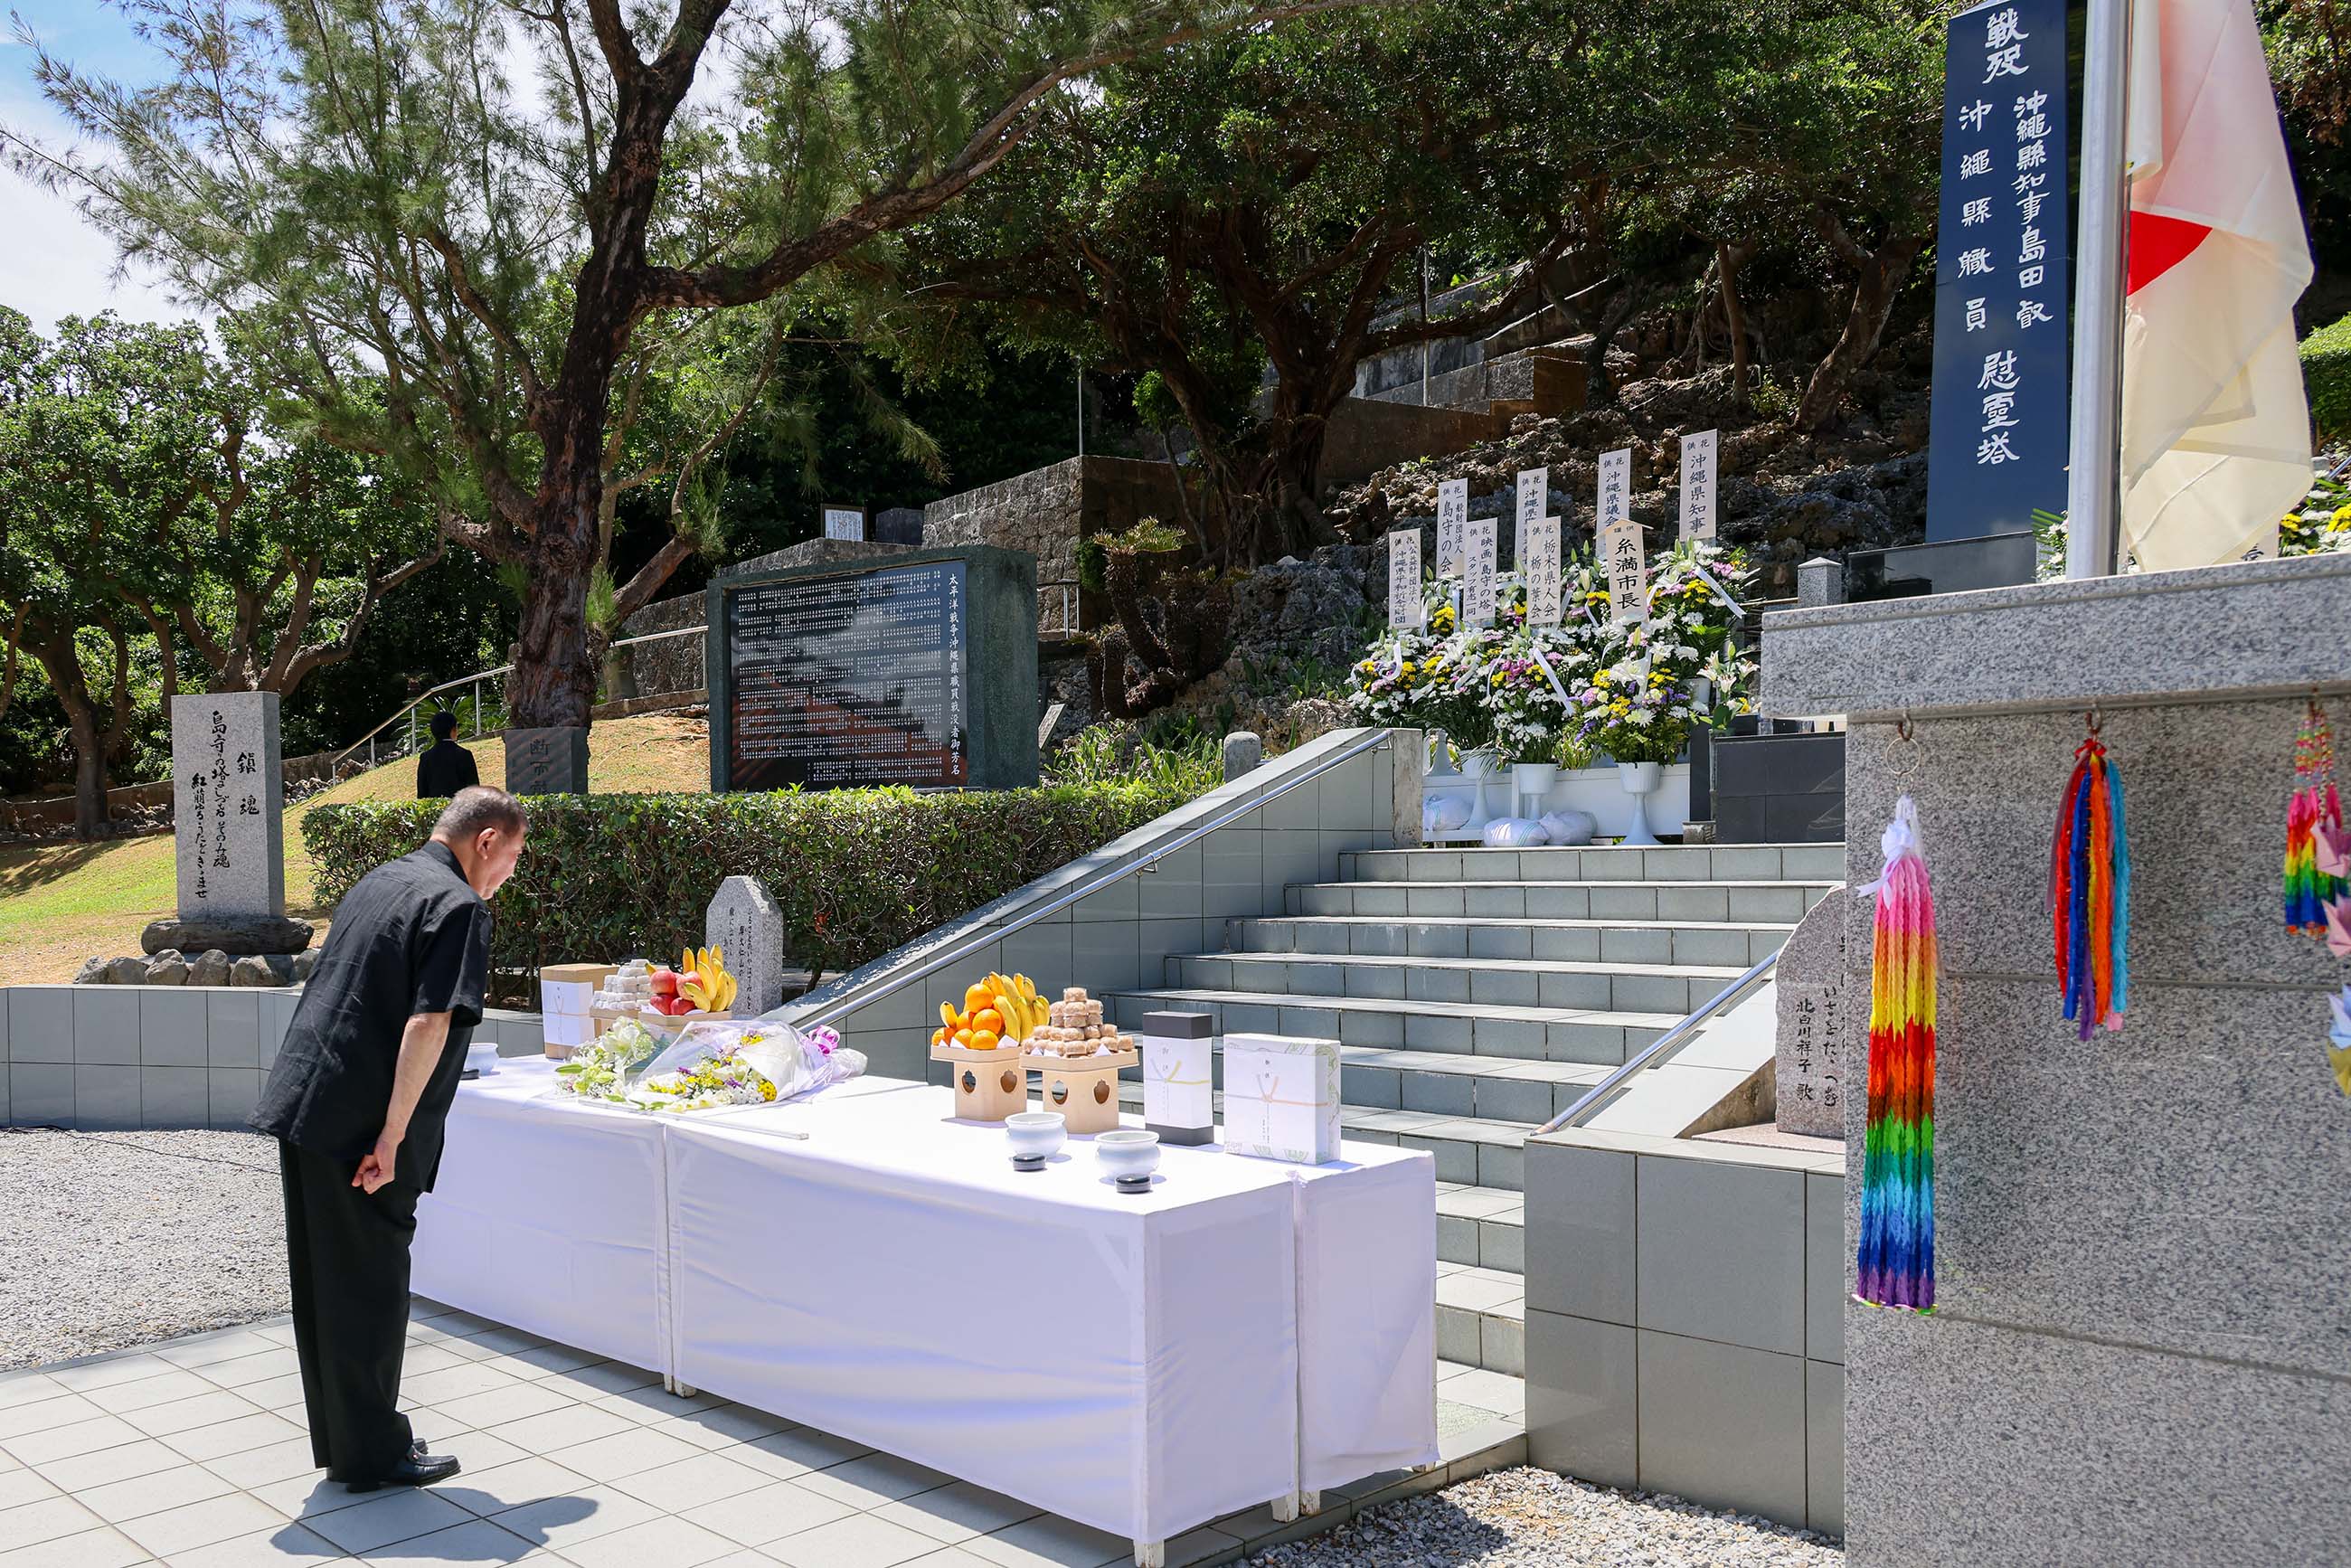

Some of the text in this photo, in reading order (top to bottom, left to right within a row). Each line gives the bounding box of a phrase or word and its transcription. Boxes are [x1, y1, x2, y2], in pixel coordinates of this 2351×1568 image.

[1440, 500, 1453, 572] 島守の会
[1531, 555, 1542, 619] 栃の葉会
[1544, 538, 1557, 618] 栃木県人会
[1615, 538, 1640, 609] 糸満市長
